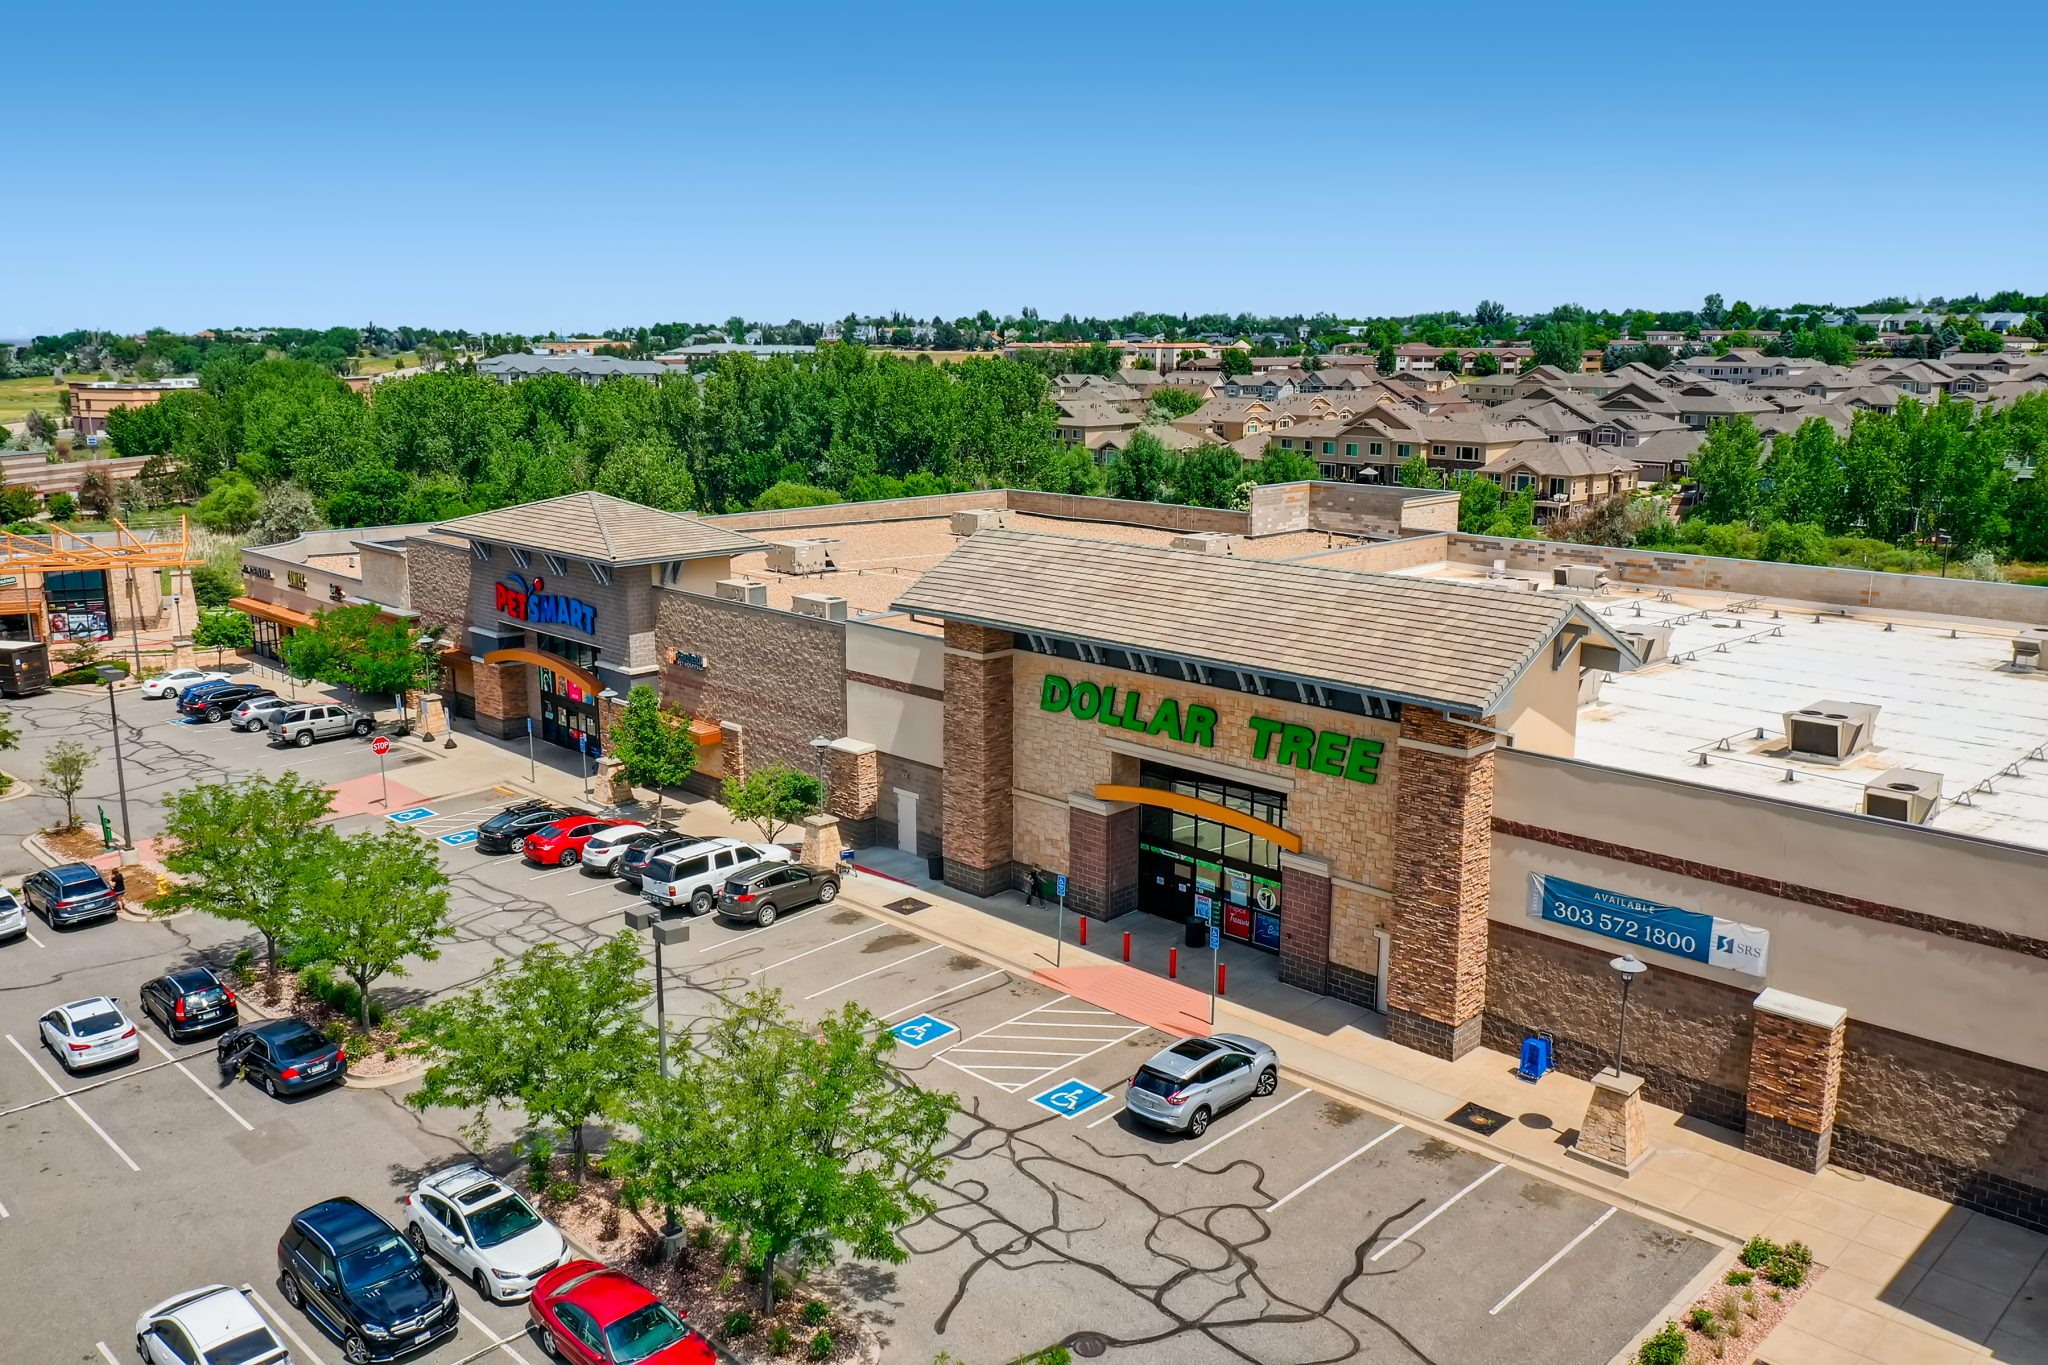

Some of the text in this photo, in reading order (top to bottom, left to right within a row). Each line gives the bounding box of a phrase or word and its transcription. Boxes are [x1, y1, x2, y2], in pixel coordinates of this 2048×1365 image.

[495, 580, 597, 635] PETSMART
[373, 741, 389, 751] STOP
[1040, 673, 1385, 785] DOLLAR TREE
[1593, 892, 1656, 915] AVAILABLE
[1553, 901, 1696, 954] 303 572 1800
[1736, 943, 1762, 959] SRS
